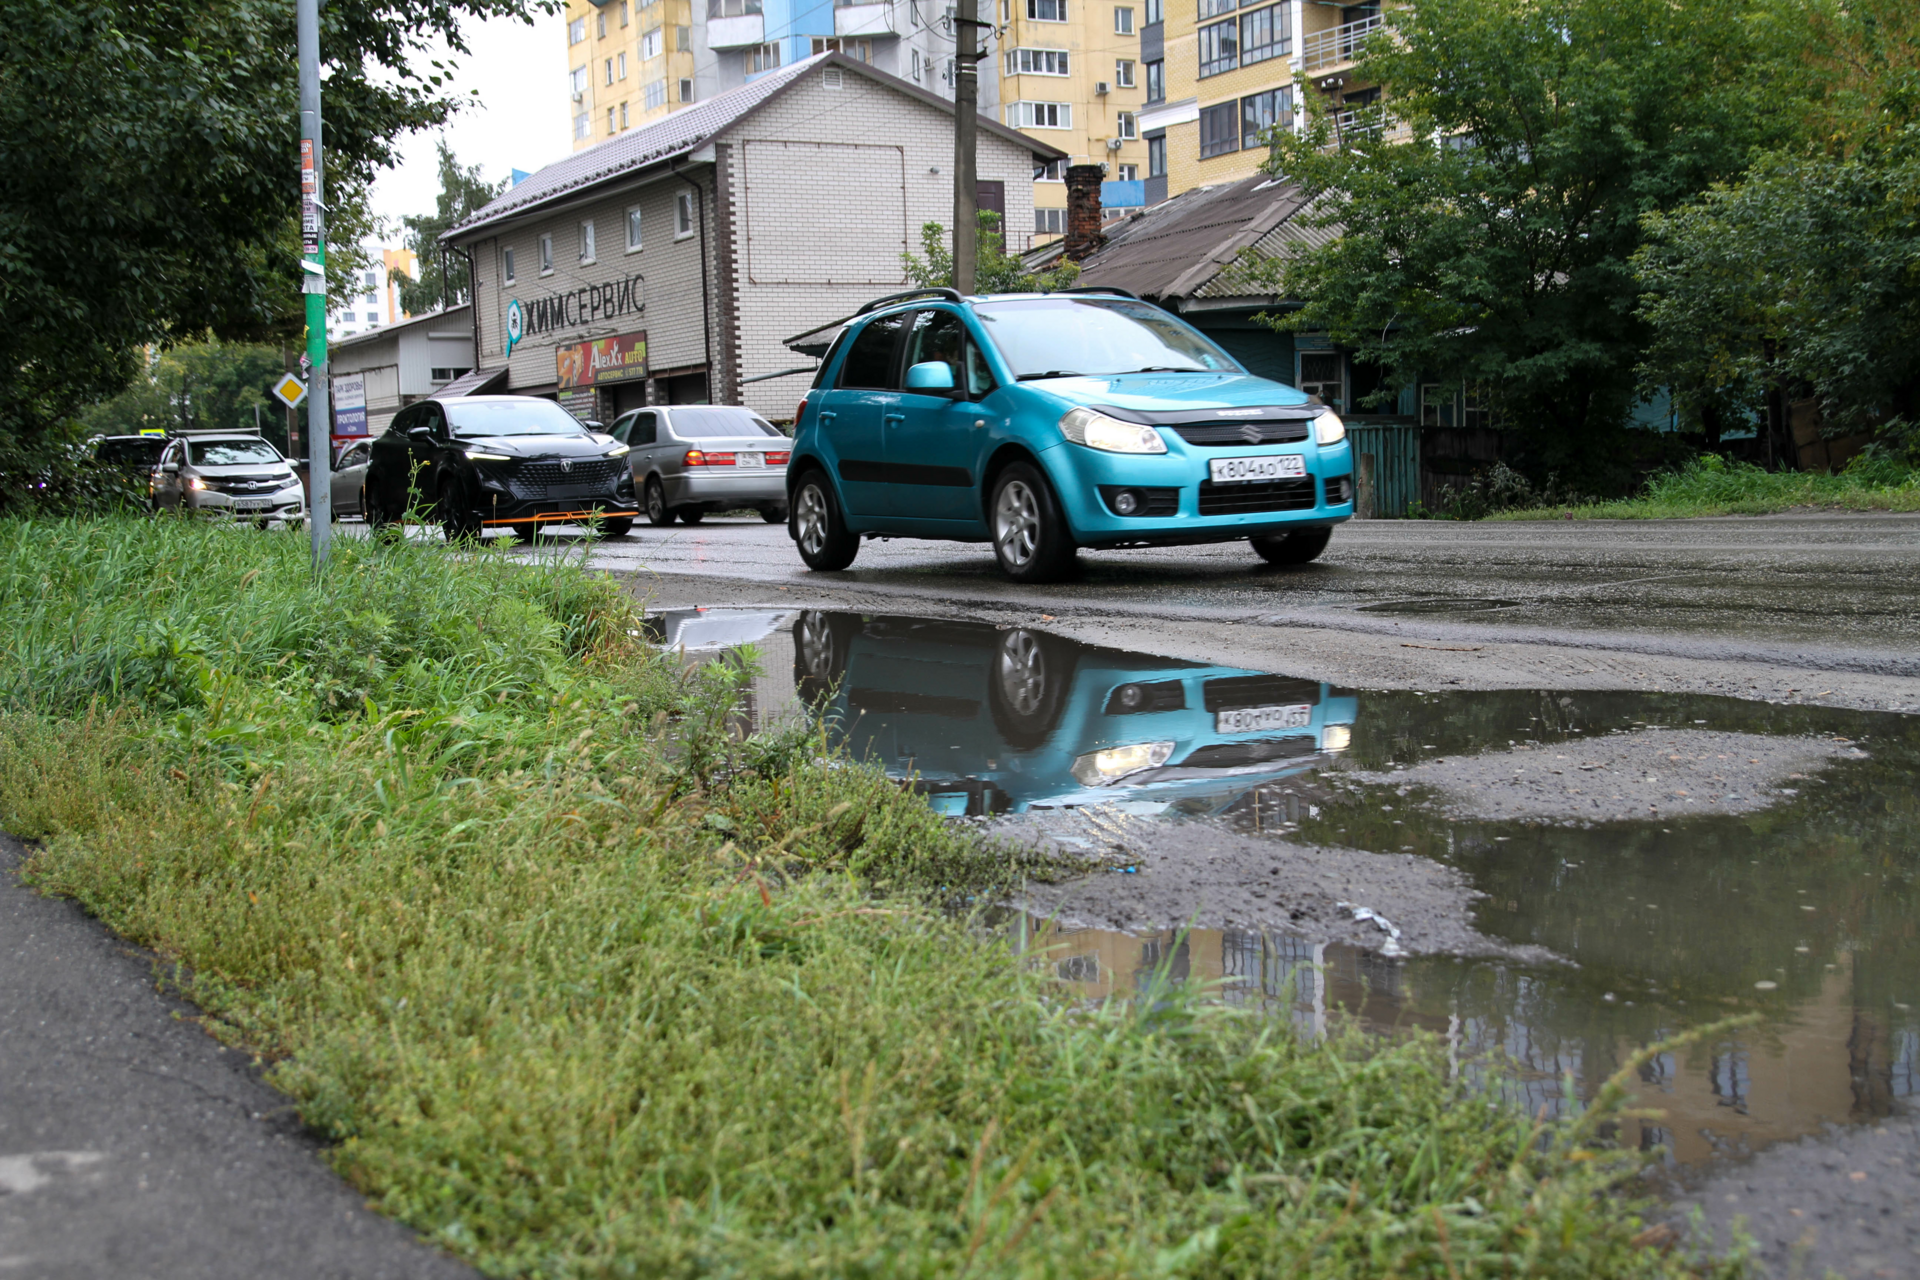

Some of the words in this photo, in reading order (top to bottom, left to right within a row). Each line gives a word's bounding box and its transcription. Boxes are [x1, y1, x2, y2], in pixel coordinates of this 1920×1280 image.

[525, 274, 645, 335] ХИМСЕРВИС
[624, 350, 643, 365] AUTO
[597, 369, 624, 381] АВТОСЕРВИС
